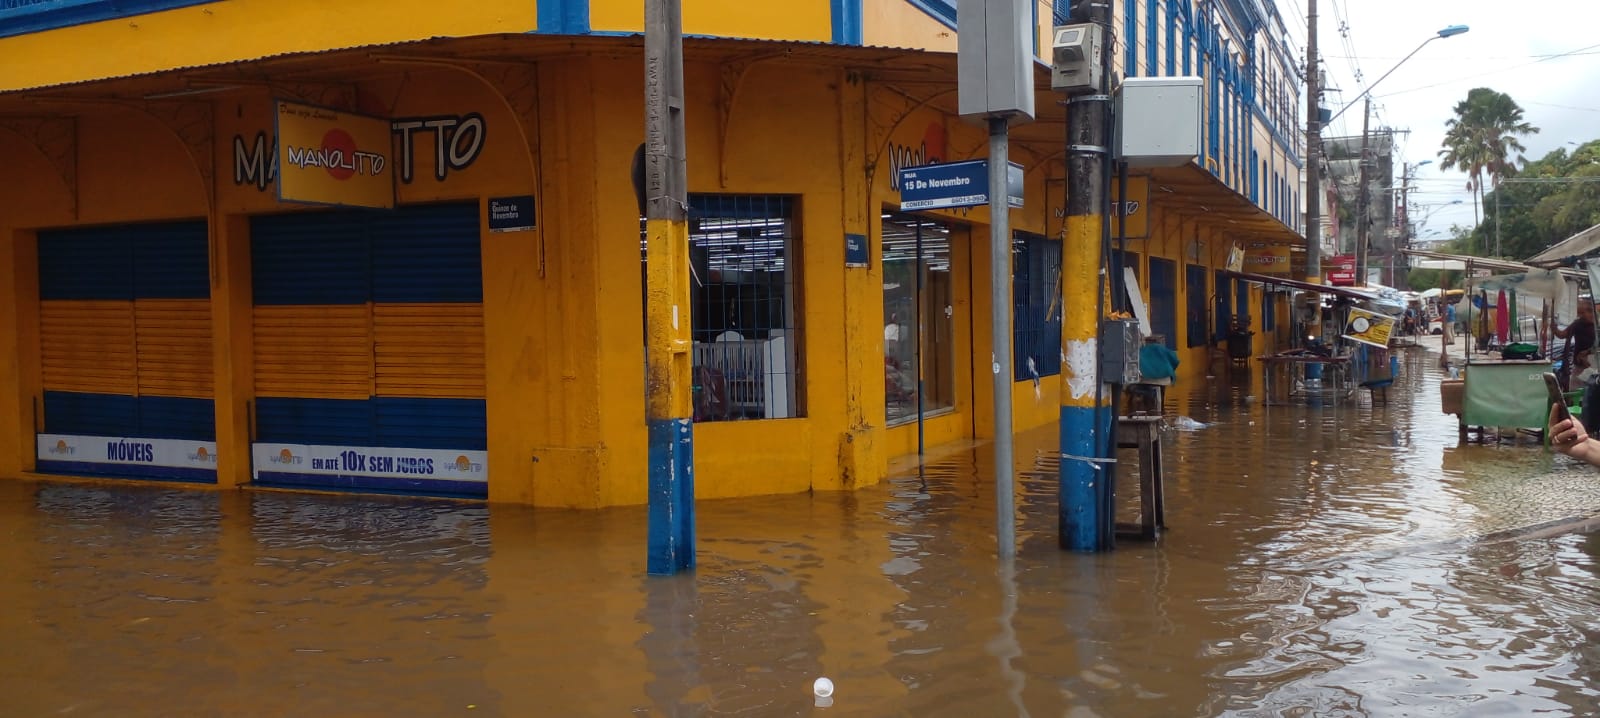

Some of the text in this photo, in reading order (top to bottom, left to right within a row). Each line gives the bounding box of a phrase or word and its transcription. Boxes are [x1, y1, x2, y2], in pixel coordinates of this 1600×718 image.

[288, 145, 385, 176] MANOLITTO
[905, 176, 971, 190] 15 De Novembro
[107, 440, 154, 462] MÓVEIS
[312, 450, 434, 475] EM ATÉ 10X SEM JUROS
